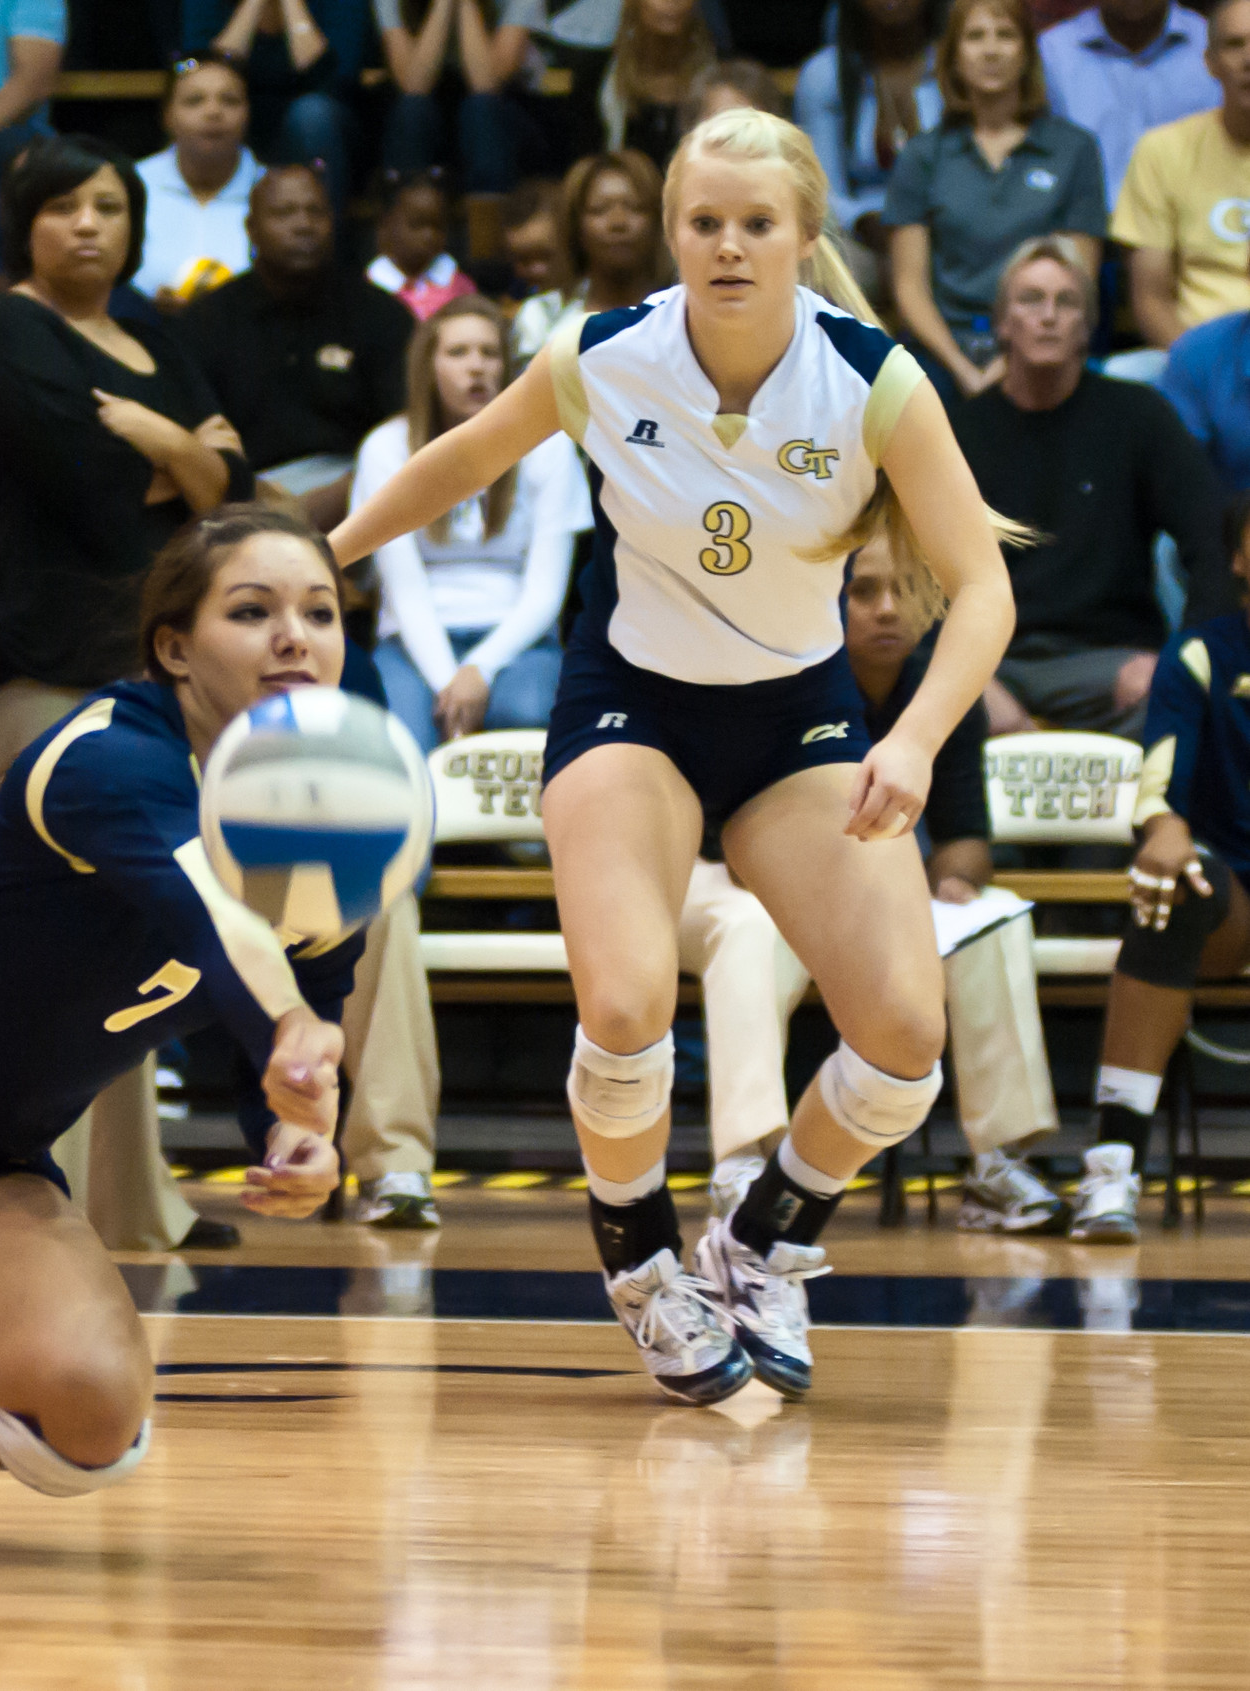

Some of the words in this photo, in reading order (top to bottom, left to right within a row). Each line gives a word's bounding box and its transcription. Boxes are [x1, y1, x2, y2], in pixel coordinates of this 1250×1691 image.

[777, 438, 840, 480] GT
[699, 500, 752, 577] 3
[1002, 782, 1117, 820] TECH
[103, 957, 202, 1033] 7
